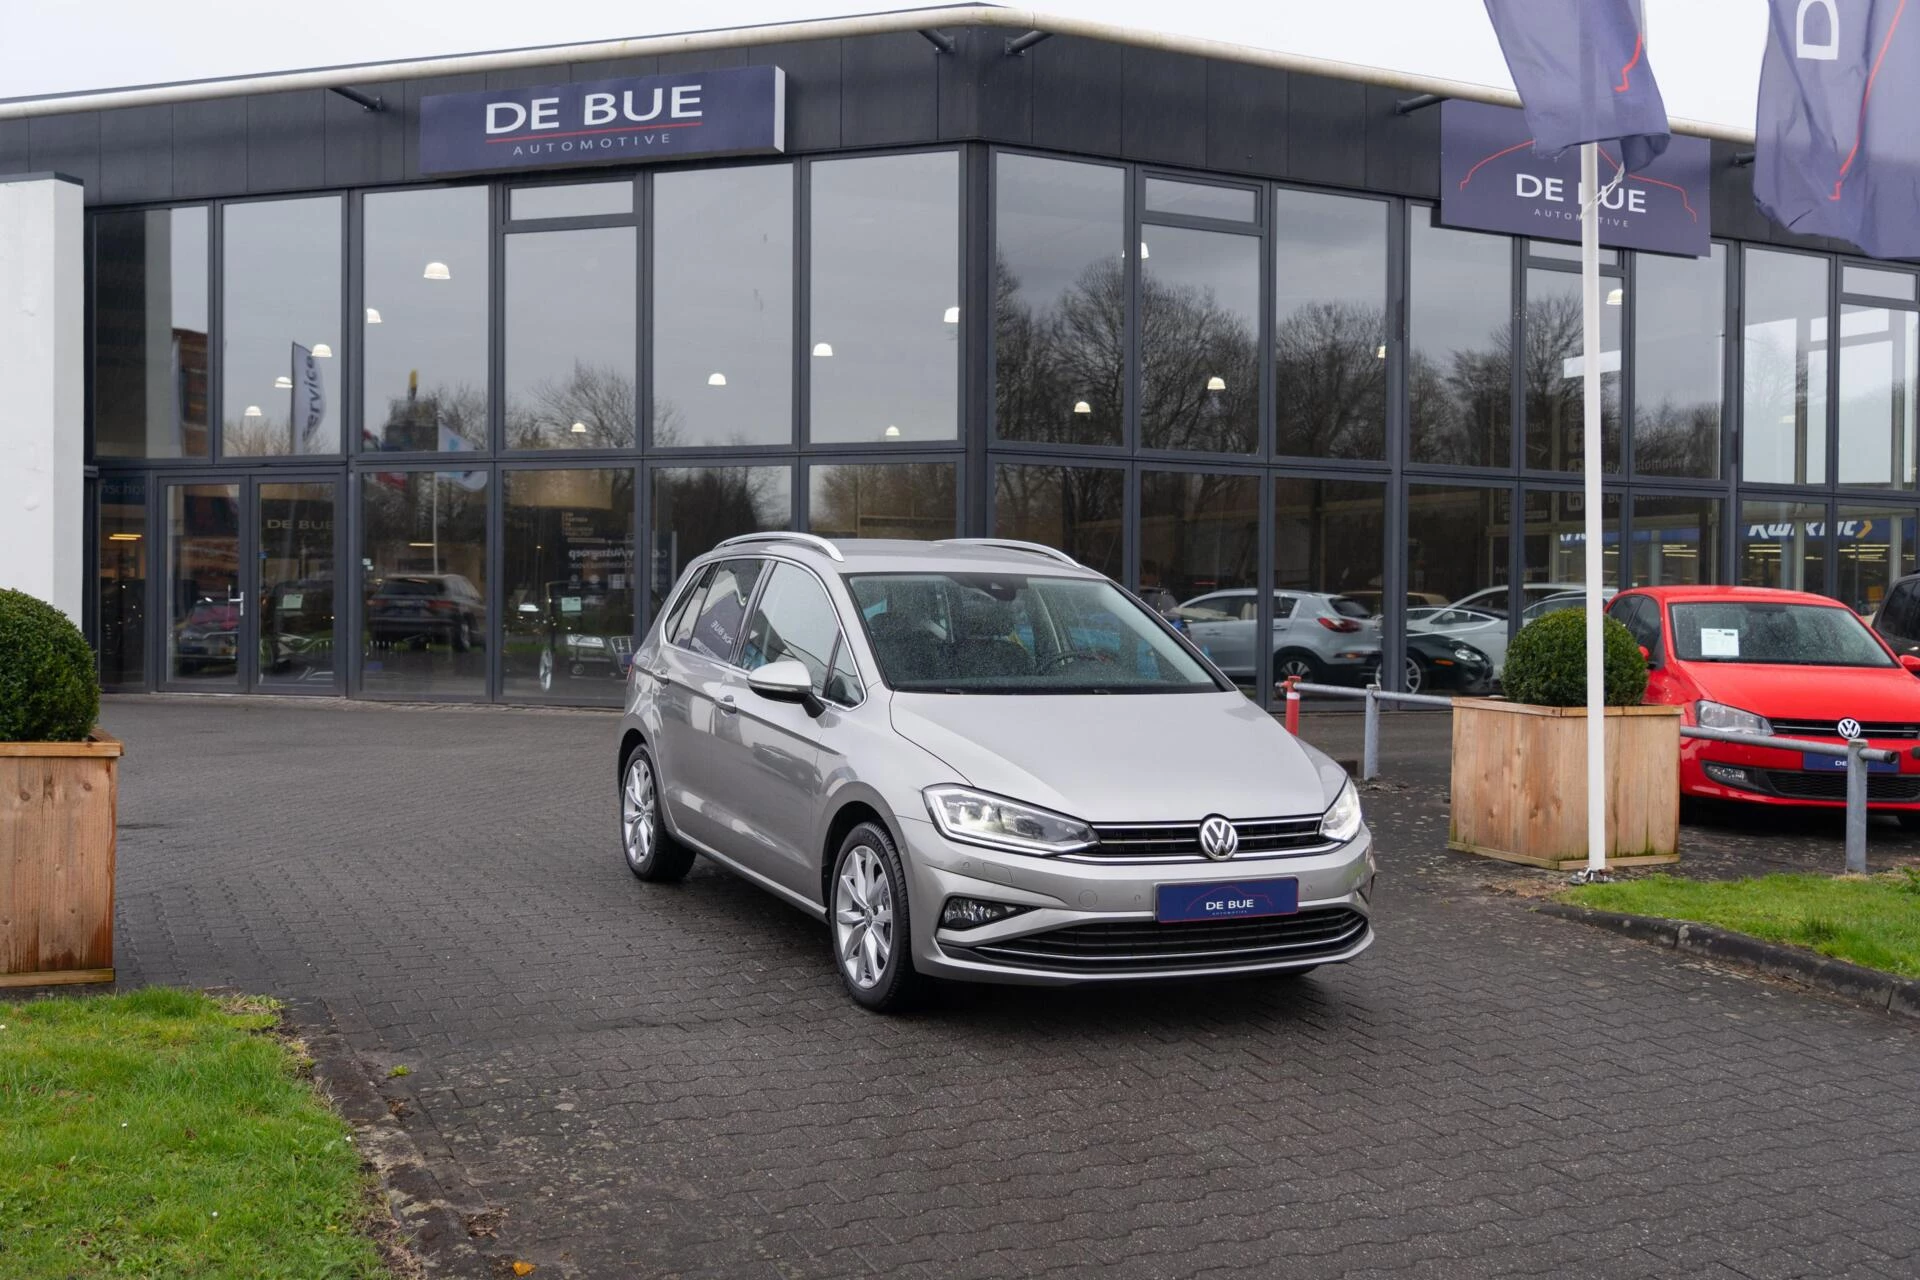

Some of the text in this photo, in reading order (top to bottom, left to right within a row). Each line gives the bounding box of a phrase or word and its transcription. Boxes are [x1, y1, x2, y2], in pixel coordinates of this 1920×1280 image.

[485, 84, 703, 135] DE BUE
[512, 133, 671, 156] AUTOMOTIVE
[1516, 173, 1647, 213] DE UE
[1534, 208, 1629, 228] AUTOMTIVE
[1205, 899, 1255, 911] DE BUE
